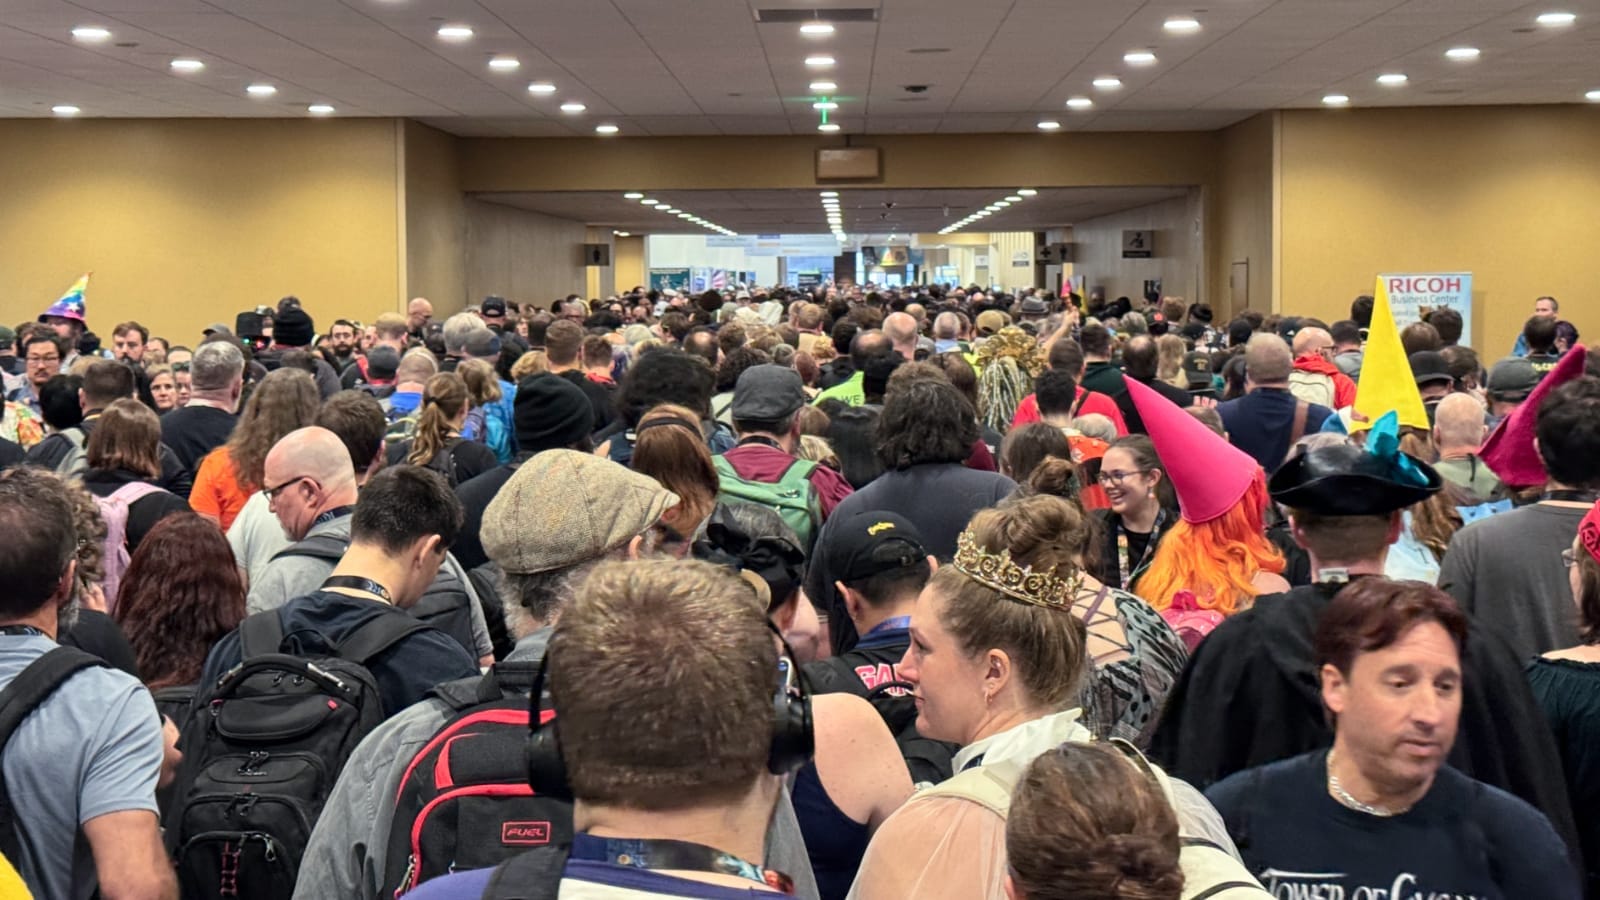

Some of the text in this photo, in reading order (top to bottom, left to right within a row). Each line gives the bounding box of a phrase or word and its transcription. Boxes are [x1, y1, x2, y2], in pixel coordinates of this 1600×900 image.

[1389, 277, 1461, 294] RICOH
[1391, 294, 1459, 304] Business Center
[507, 828, 544, 837] FUEL
